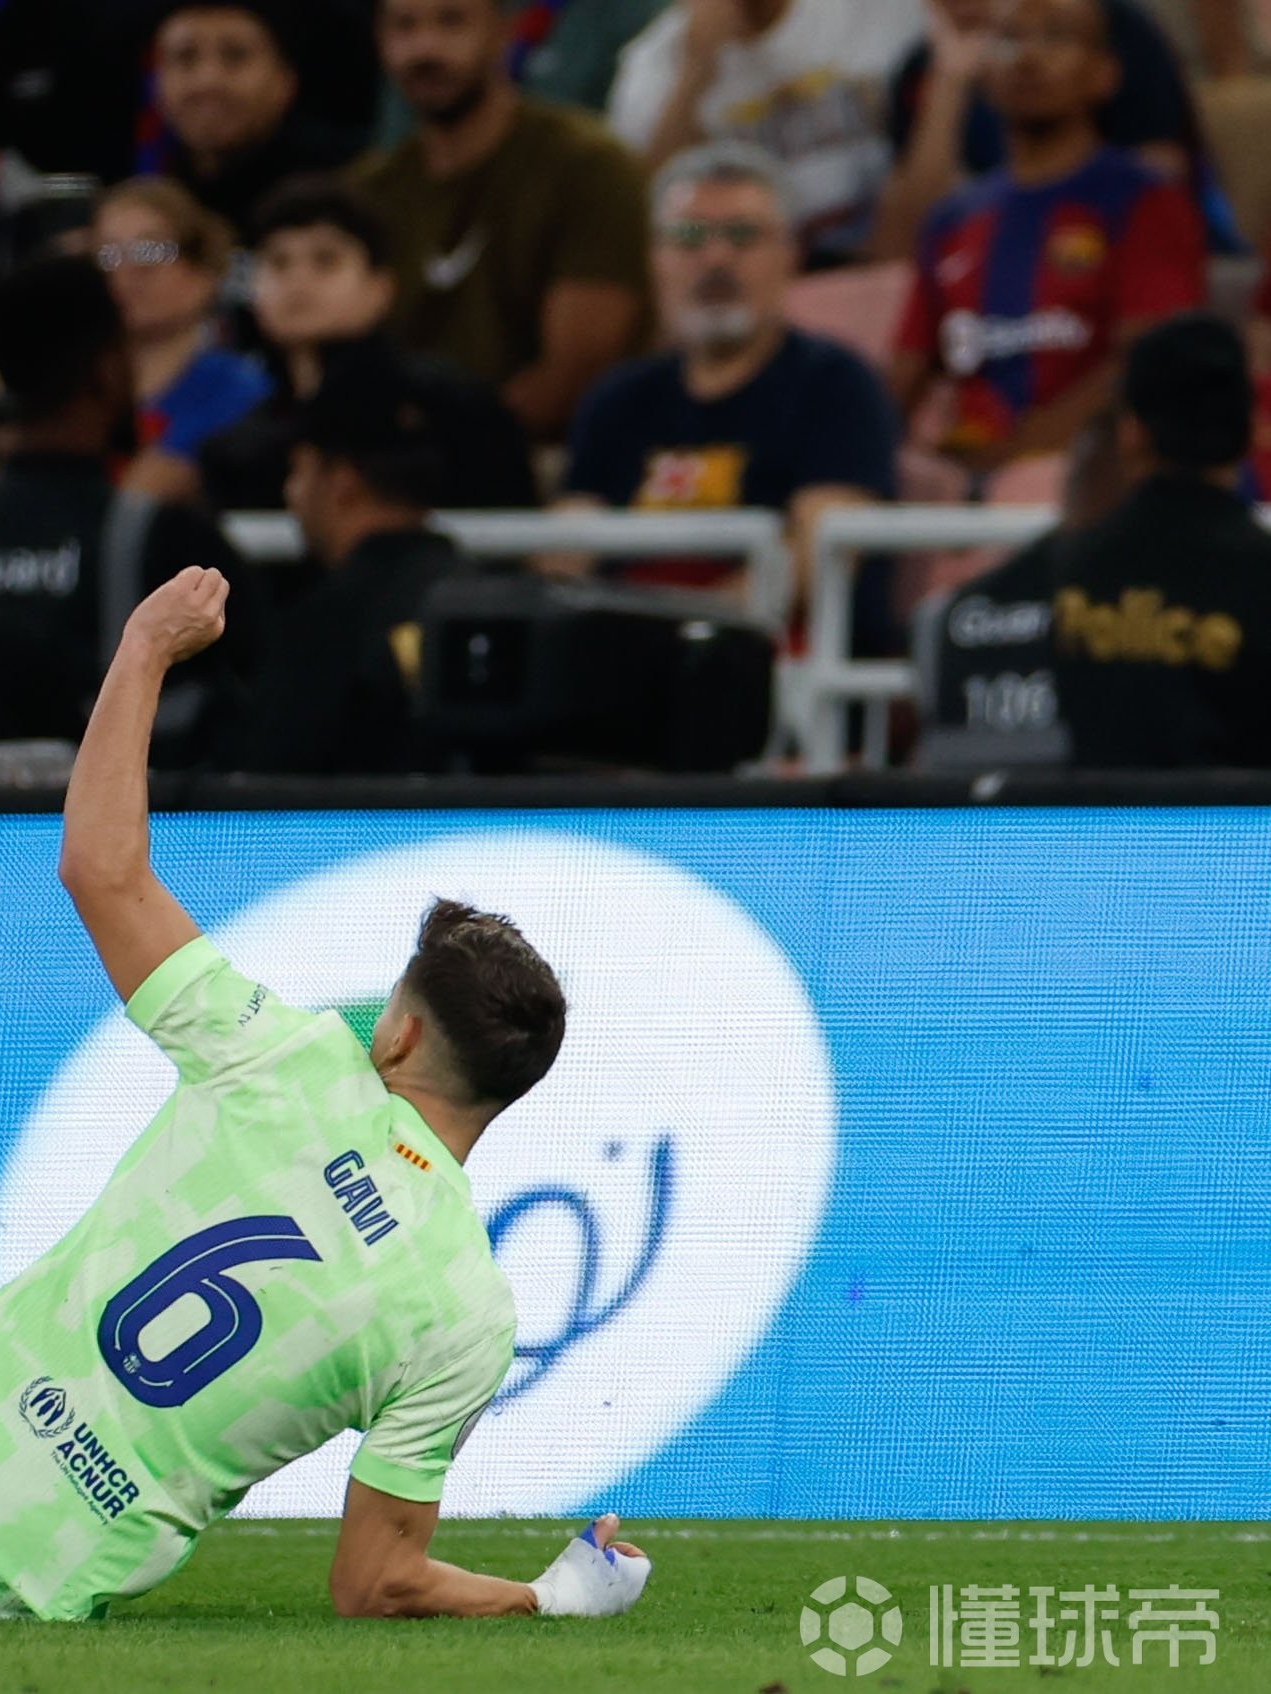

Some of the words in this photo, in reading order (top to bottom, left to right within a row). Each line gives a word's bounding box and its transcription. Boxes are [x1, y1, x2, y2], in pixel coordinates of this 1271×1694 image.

[948, 596, 1052, 648] Guar
[324, 1149, 399, 1247] GAVI
[97, 1215, 323, 1408] 6
[56, 1440, 125, 1518] ACNUR
[74, 1422, 140, 1505] UNHCR
